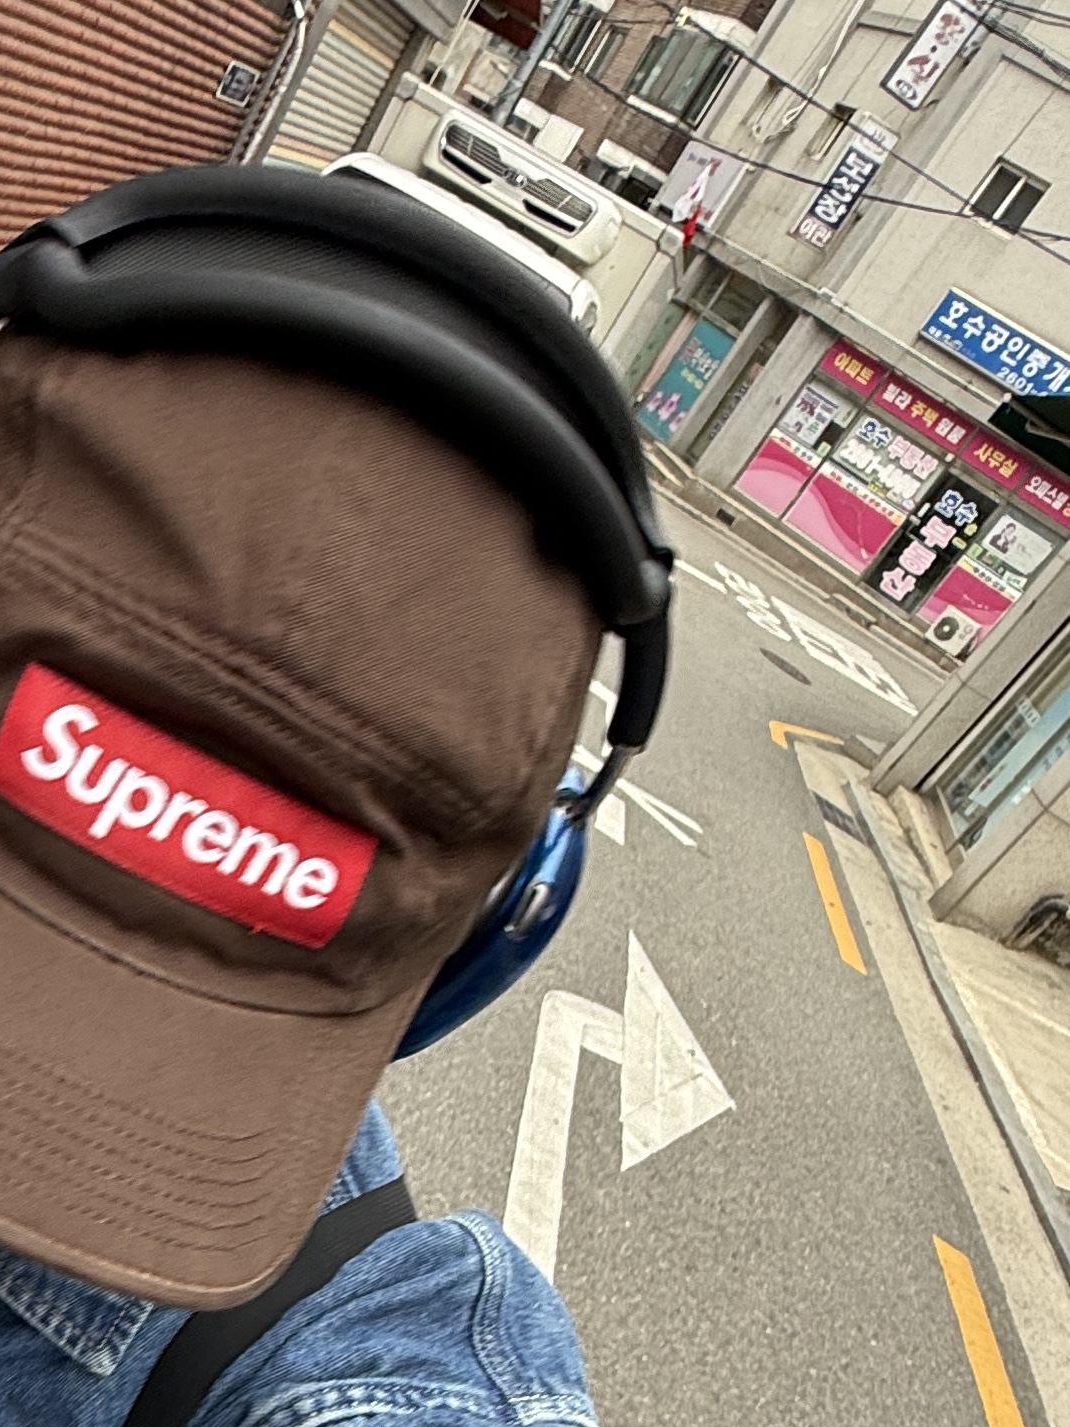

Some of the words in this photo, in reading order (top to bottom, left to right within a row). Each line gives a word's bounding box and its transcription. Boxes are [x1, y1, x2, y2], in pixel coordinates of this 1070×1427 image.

[834, 352, 875, 386] 아파트
[938, 300, 1070, 393] 호수공인중개
[882, 383, 912, 411] 빌라
[910, 400, 940, 428] 주택
[856, 418, 893, 449] 호수
[888, 435, 939, 480] 부동산
[973, 443, 1019, 478] 사무실
[934, 490, 979, 527] 호수
[1025, 475, 1069, 511] 오피스텔
[879, 515, 957, 602] 부동산
[20, 704, 339, 909] Supreme
